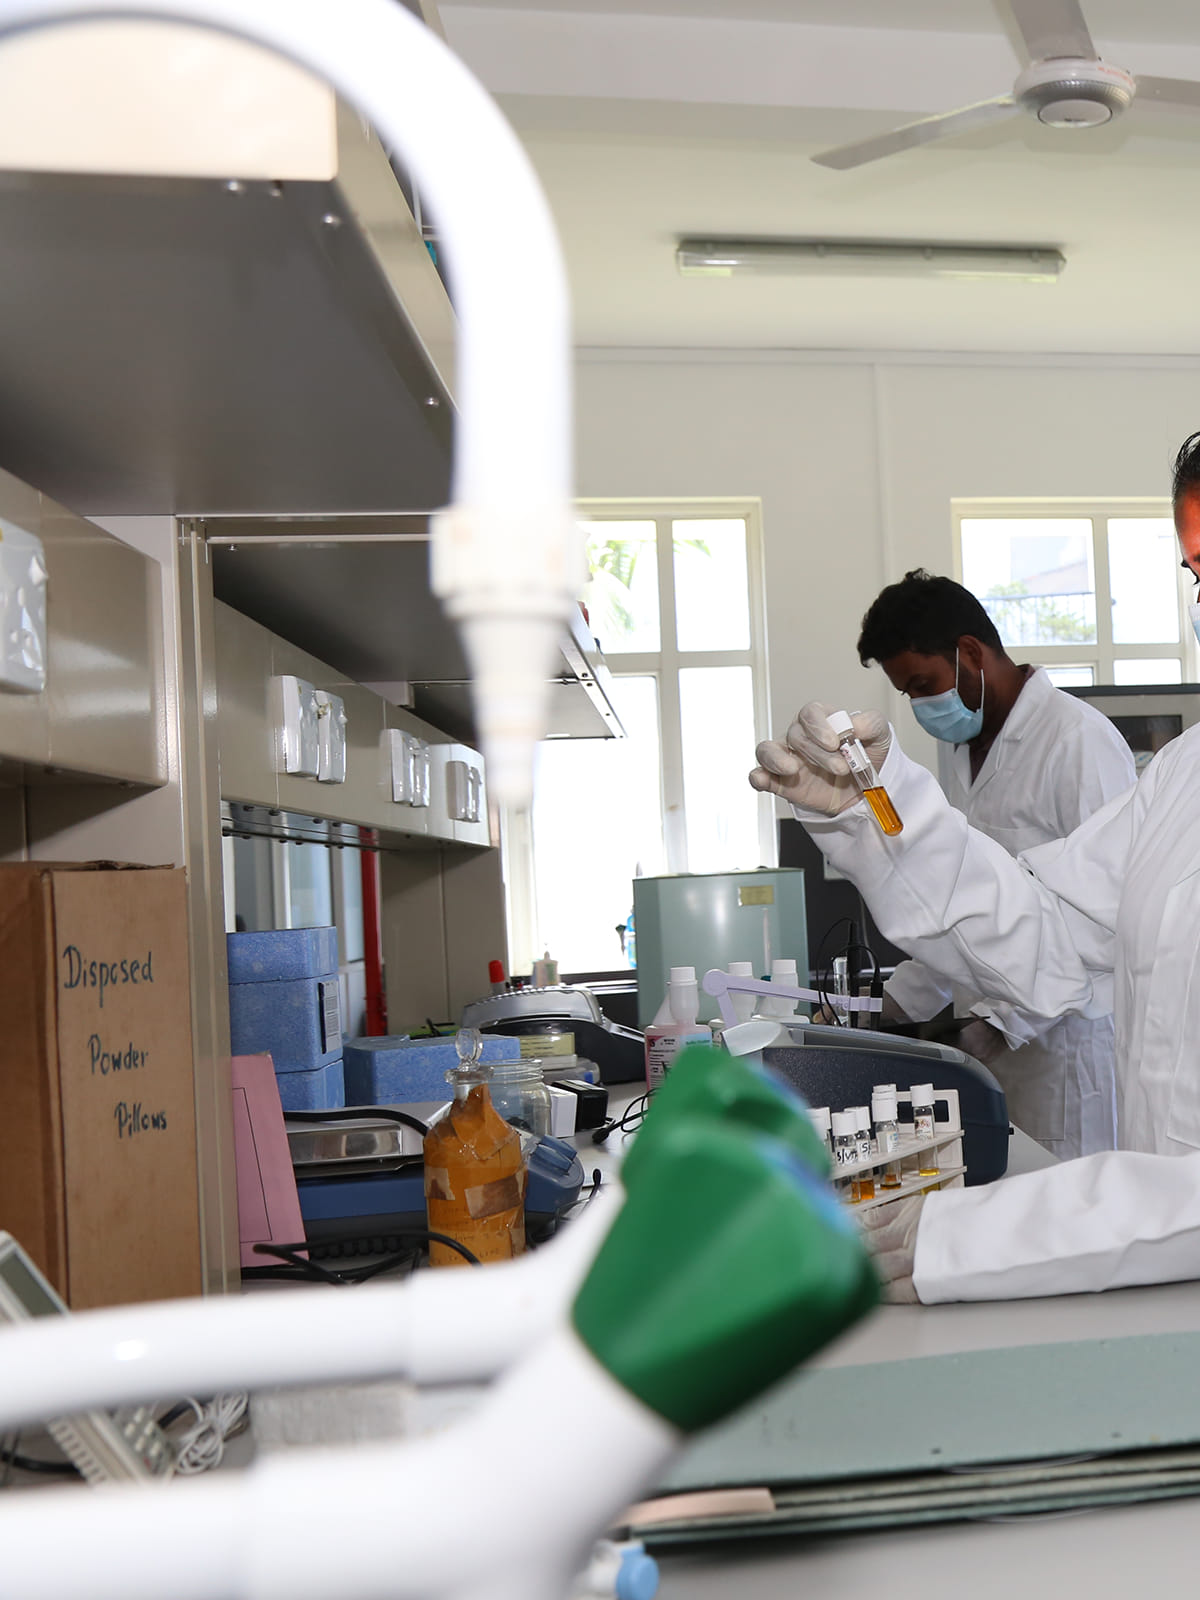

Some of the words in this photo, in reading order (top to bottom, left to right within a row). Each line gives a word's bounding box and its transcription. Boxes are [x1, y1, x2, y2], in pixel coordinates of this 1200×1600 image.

[63, 944, 154, 1008] Disposed
[87, 1033, 149, 1075] Powder
[114, 1101, 167, 1139] Pillows
